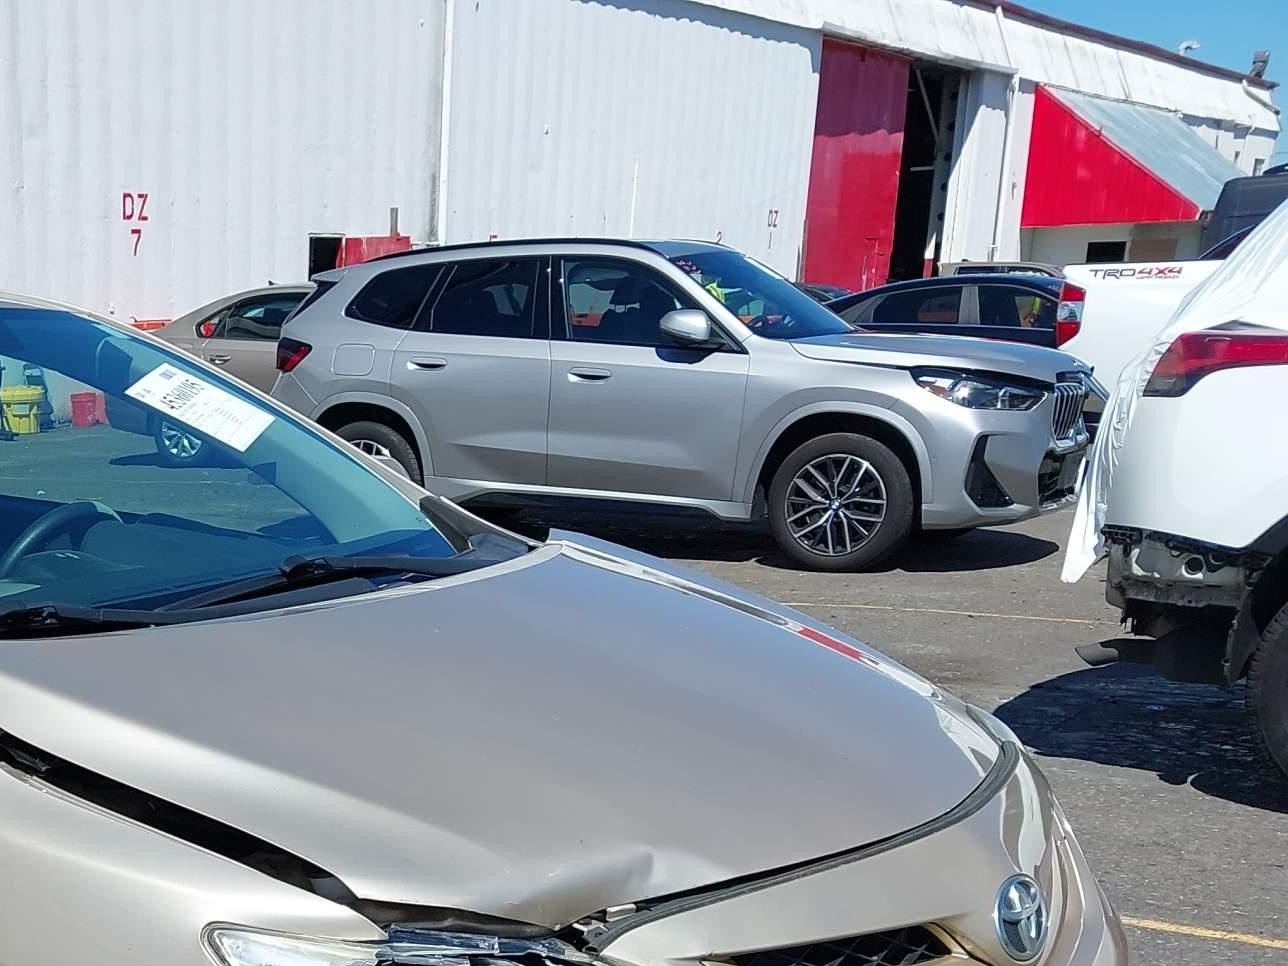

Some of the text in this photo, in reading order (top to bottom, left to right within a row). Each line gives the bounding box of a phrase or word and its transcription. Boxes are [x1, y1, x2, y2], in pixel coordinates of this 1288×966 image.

[122, 192, 149, 221] DZ
[130, 228, 142, 256] 7
[1089, 268, 1136, 280] TRD
